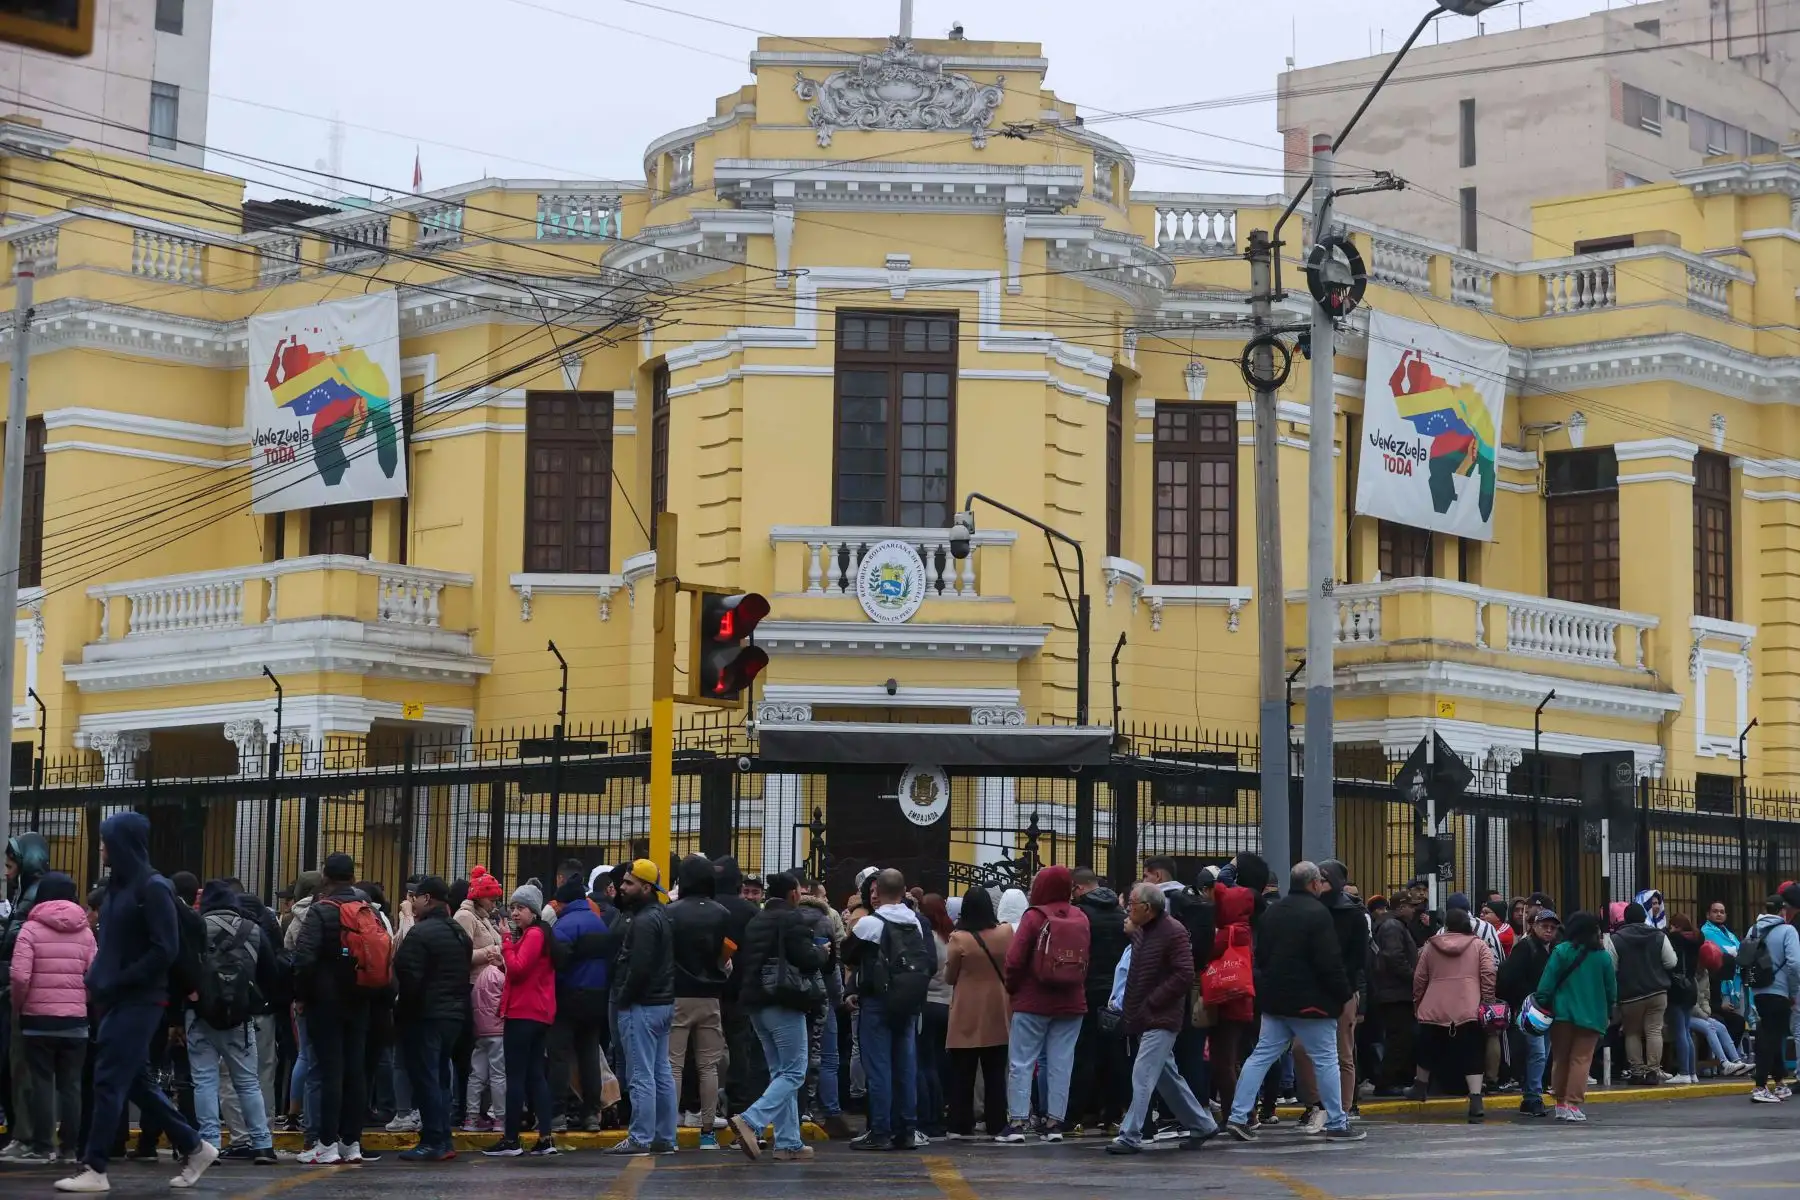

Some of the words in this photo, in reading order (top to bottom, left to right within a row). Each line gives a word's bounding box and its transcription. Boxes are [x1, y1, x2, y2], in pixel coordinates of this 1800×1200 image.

[264, 446, 296, 465] TODA
[1383, 454, 1412, 477] TODA
[868, 543, 912, 560] BOLIVARIANA
[907, 810, 940, 822] EMBAJADA
